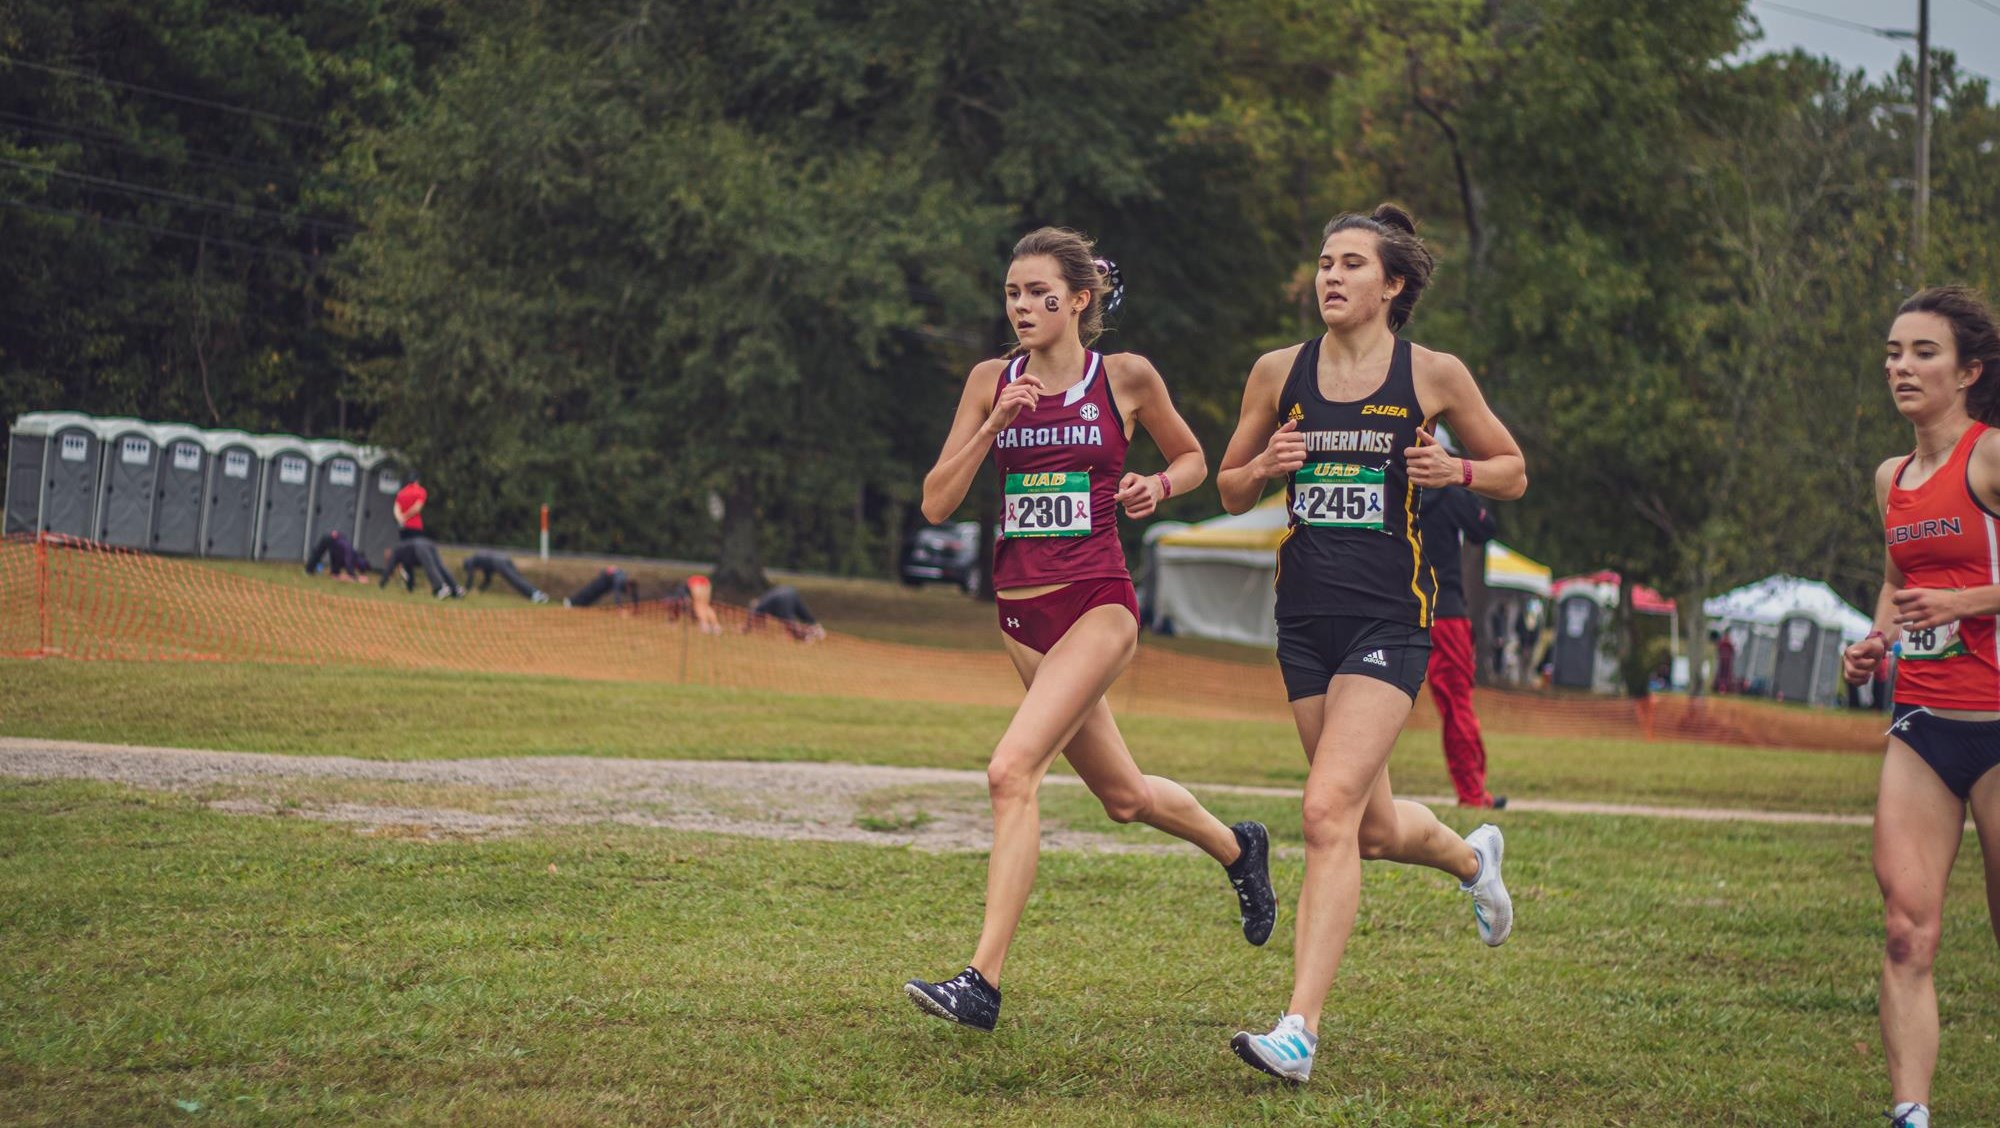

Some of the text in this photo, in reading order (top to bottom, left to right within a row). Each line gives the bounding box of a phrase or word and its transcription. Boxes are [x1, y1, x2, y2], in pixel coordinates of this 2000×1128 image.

[1081, 405, 1098, 420] SEC
[997, 425, 1103, 449] CAROLINA
[1359, 430, 1393, 454] MISS
[1023, 473, 1067, 486] UAB
[1313, 463, 1361, 476] UAB
[1018, 495, 1073, 528] 230
[1307, 486, 1366, 520] 245
